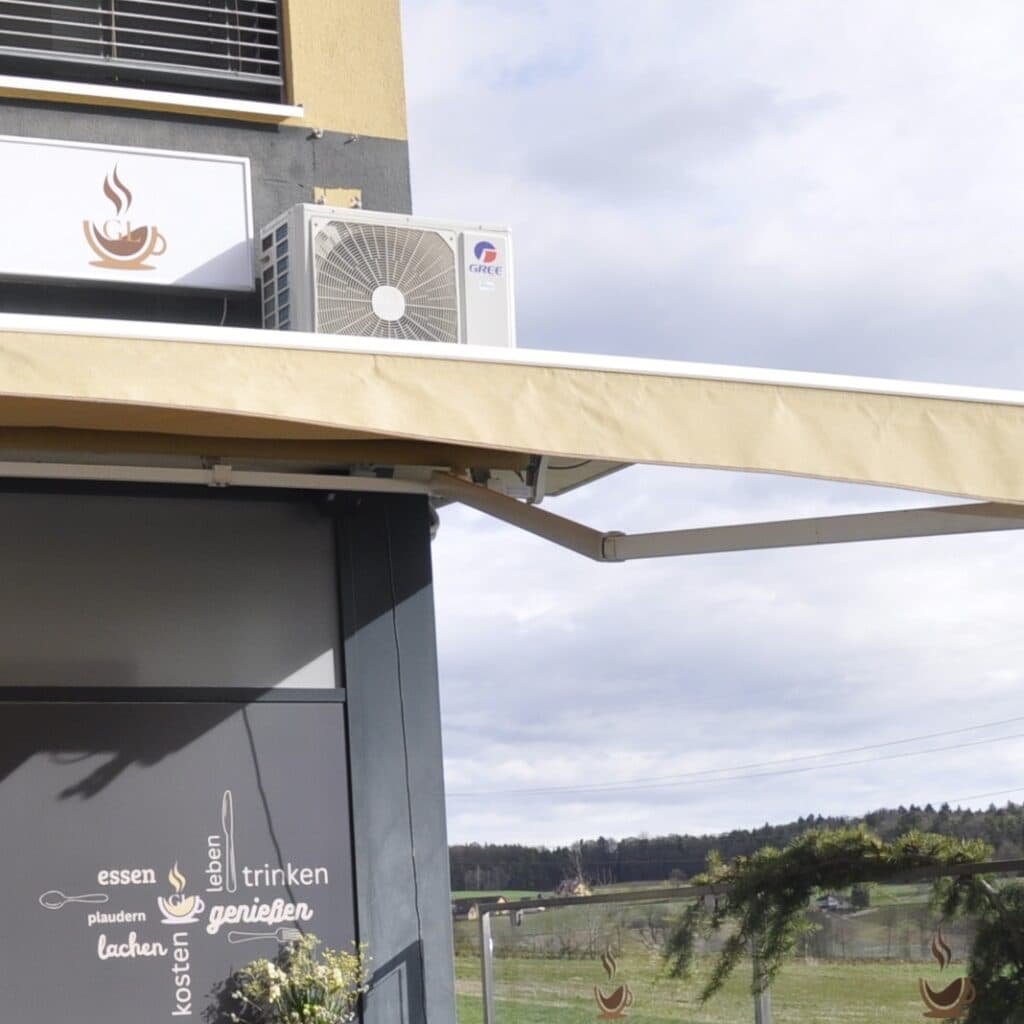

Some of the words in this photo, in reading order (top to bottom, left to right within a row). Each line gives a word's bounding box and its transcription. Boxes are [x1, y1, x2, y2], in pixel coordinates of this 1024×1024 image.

[469, 264, 503, 276] GREE
[97, 868, 156, 885] essen
[206, 835, 223, 892] leben
[242, 863, 328, 887] trinken
[88, 910, 146, 927] plaudern
[206, 897, 313, 935] genießen
[97, 931, 168, 960] lachen
[171, 932, 193, 1016] kosten
